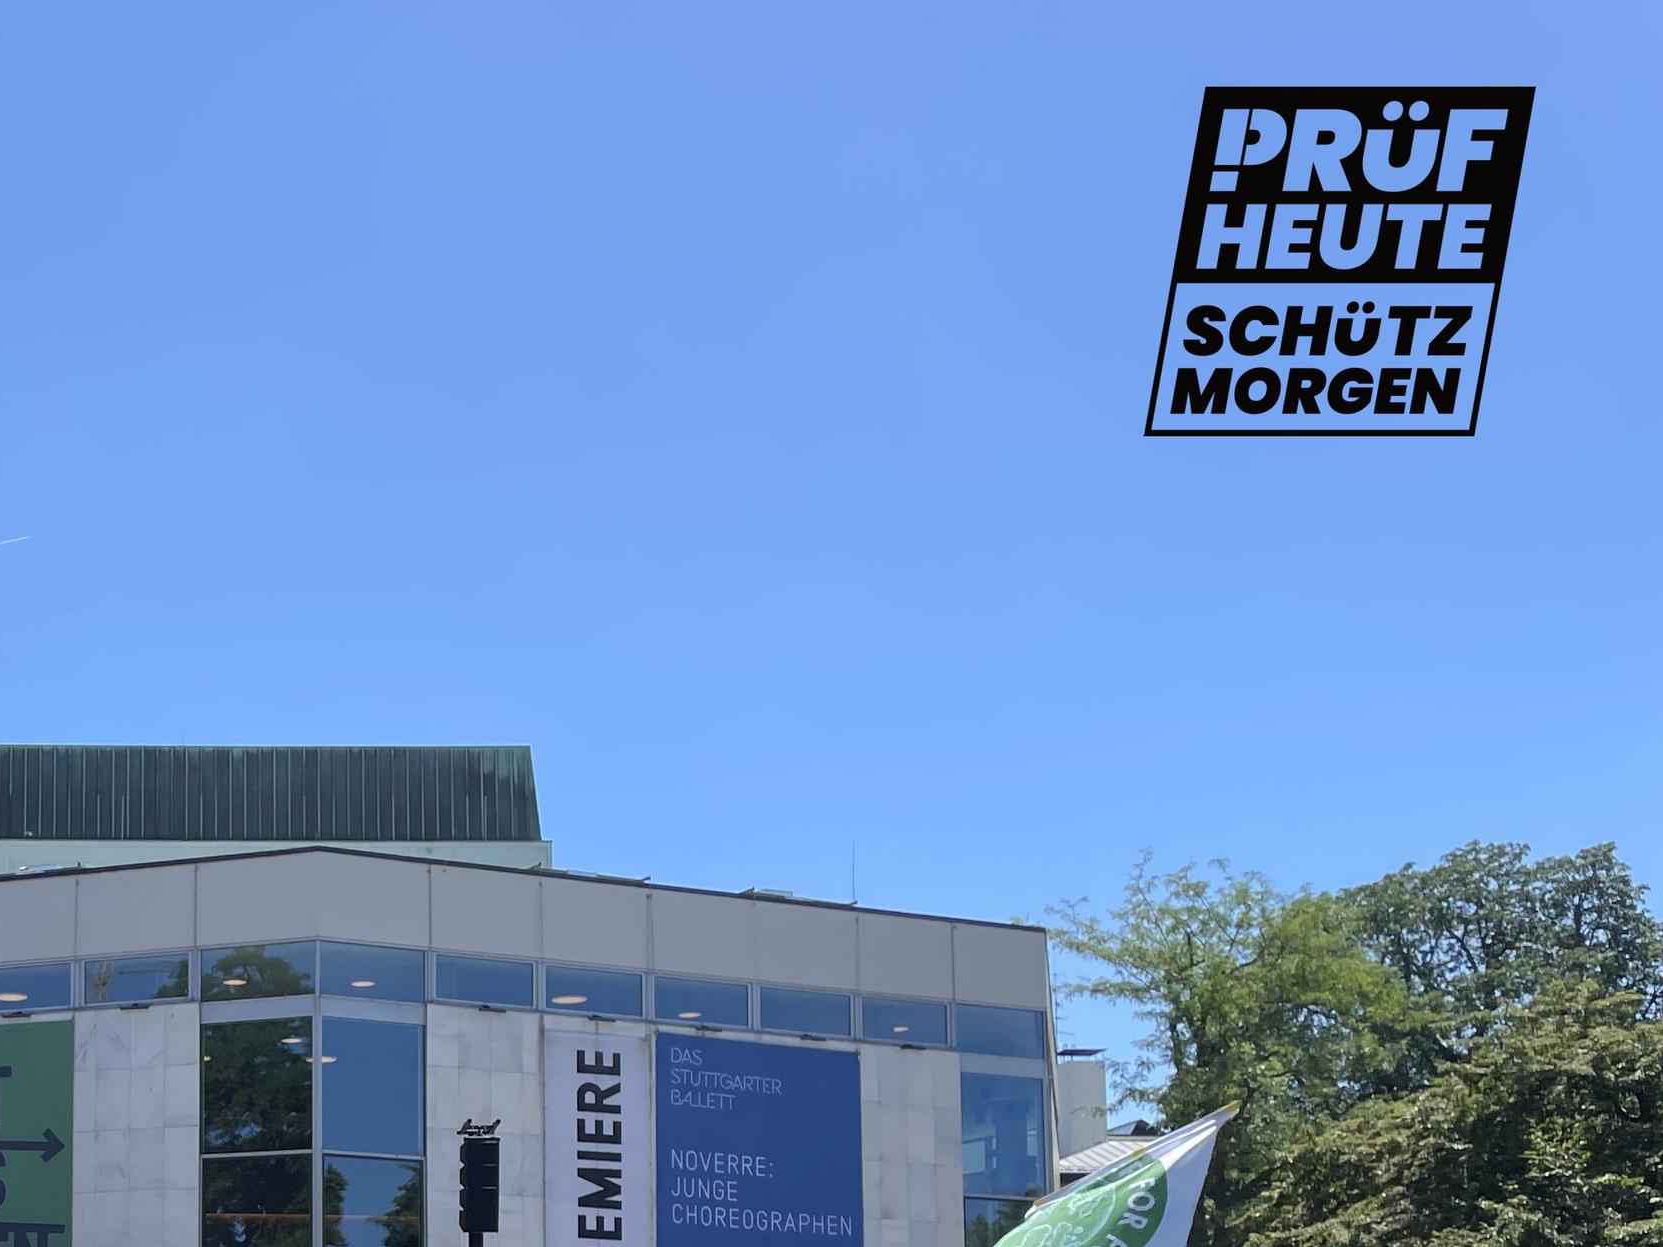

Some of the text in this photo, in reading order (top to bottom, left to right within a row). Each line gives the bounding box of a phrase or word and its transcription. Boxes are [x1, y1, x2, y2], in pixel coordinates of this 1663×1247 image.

[670, 1047, 703, 1065] DAS
[670, 1069, 783, 1095] STUTTGARTER
[670, 1089, 735, 1110] BALLETT
[671, 1149, 774, 1178] NOVERRE:
[670, 1176, 739, 1201] JUNGE
[1117, 1177, 1156, 1232] FOR
[671, 1203, 853, 1236] CHOREOGRAPHEN
